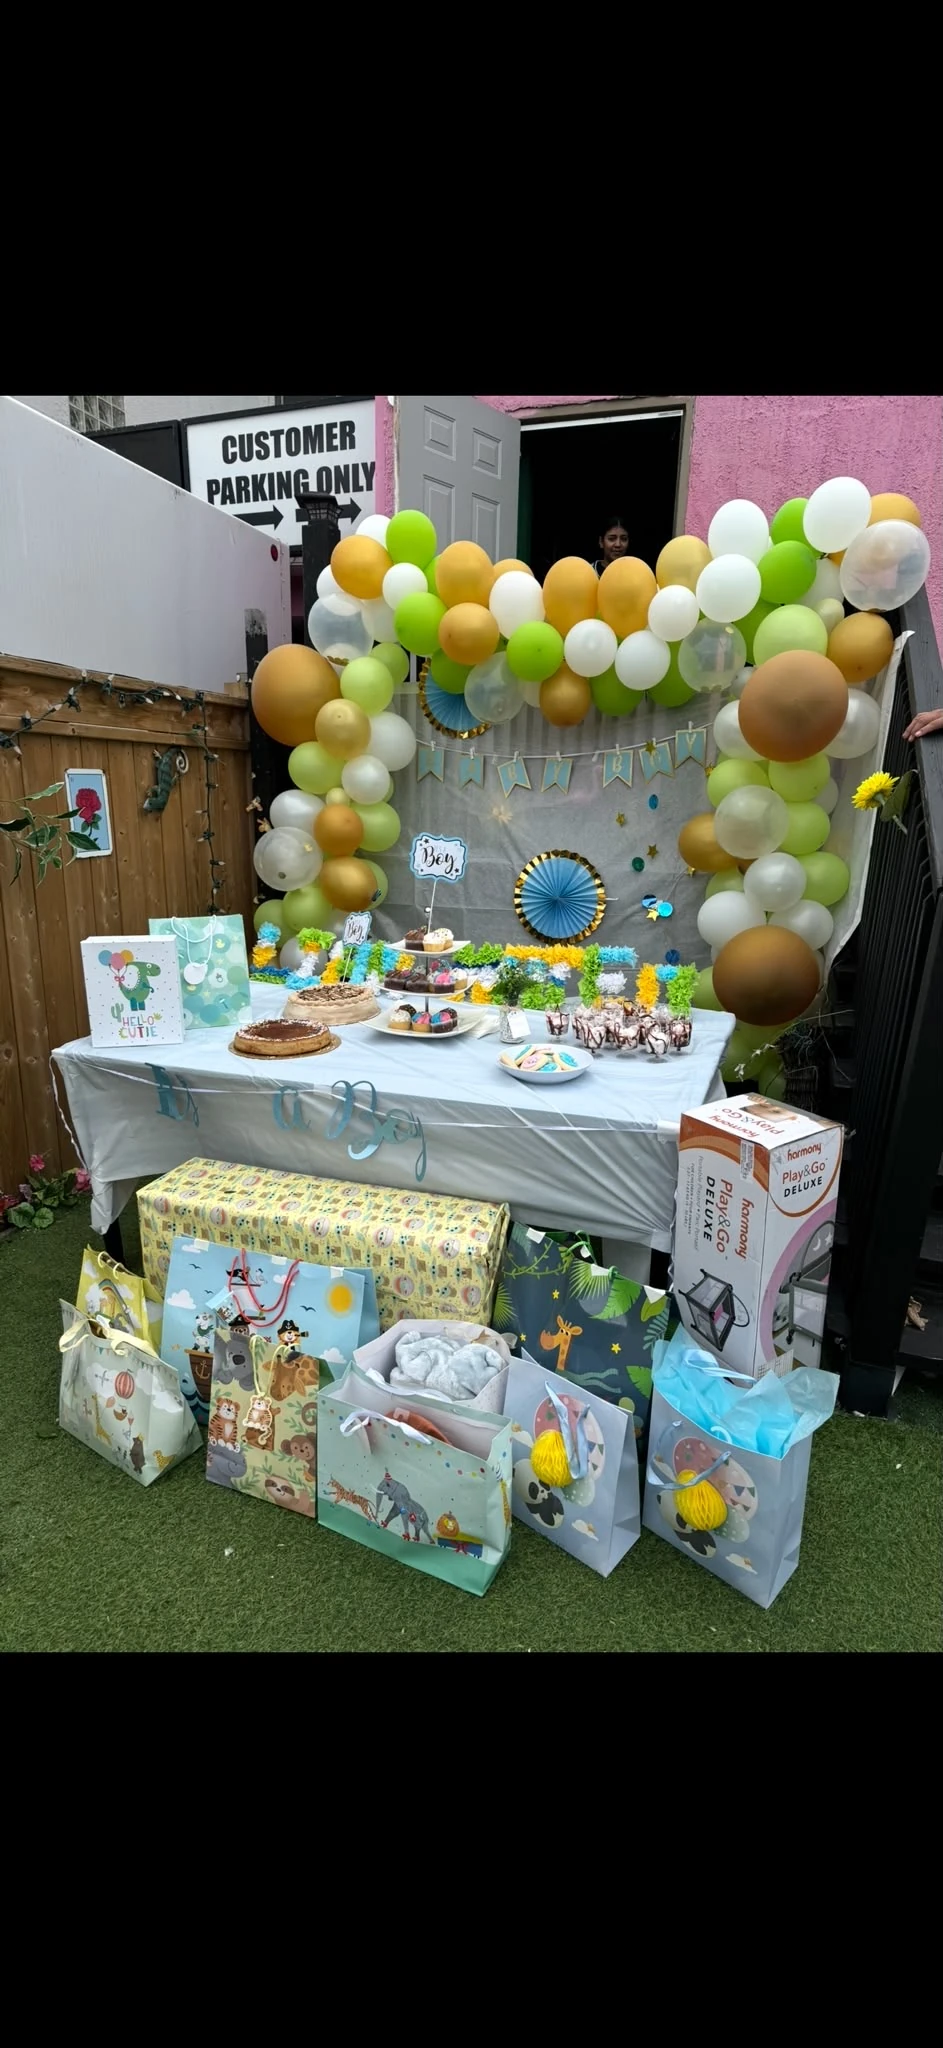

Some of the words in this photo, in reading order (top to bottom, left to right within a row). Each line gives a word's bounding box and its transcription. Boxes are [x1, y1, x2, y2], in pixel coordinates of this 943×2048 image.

[222, 420, 356, 464] CUSTOMER
[206, 468, 310, 506] PARKING
[316, 461, 376, 495] ONLY
[421, 845, 457, 875] Boy
[347, 921, 363, 942] Boy
[119, 1026, 158, 1039] CUTIE
[122, 1014, 155, 1027] HELLO
[709, 1115, 761, 1138] harmony
[721, 1108, 785, 1135] Play&Go
[787, 1143, 822, 1161] harmony
[782, 1161, 826, 1184] Play&Go
[784, 1176, 823, 1197] DELUXE
[703, 1176, 715, 1242] DELUXE
[716, 1179, 733, 1253] Play&Go
[735, 1198, 754, 1260] harmony
